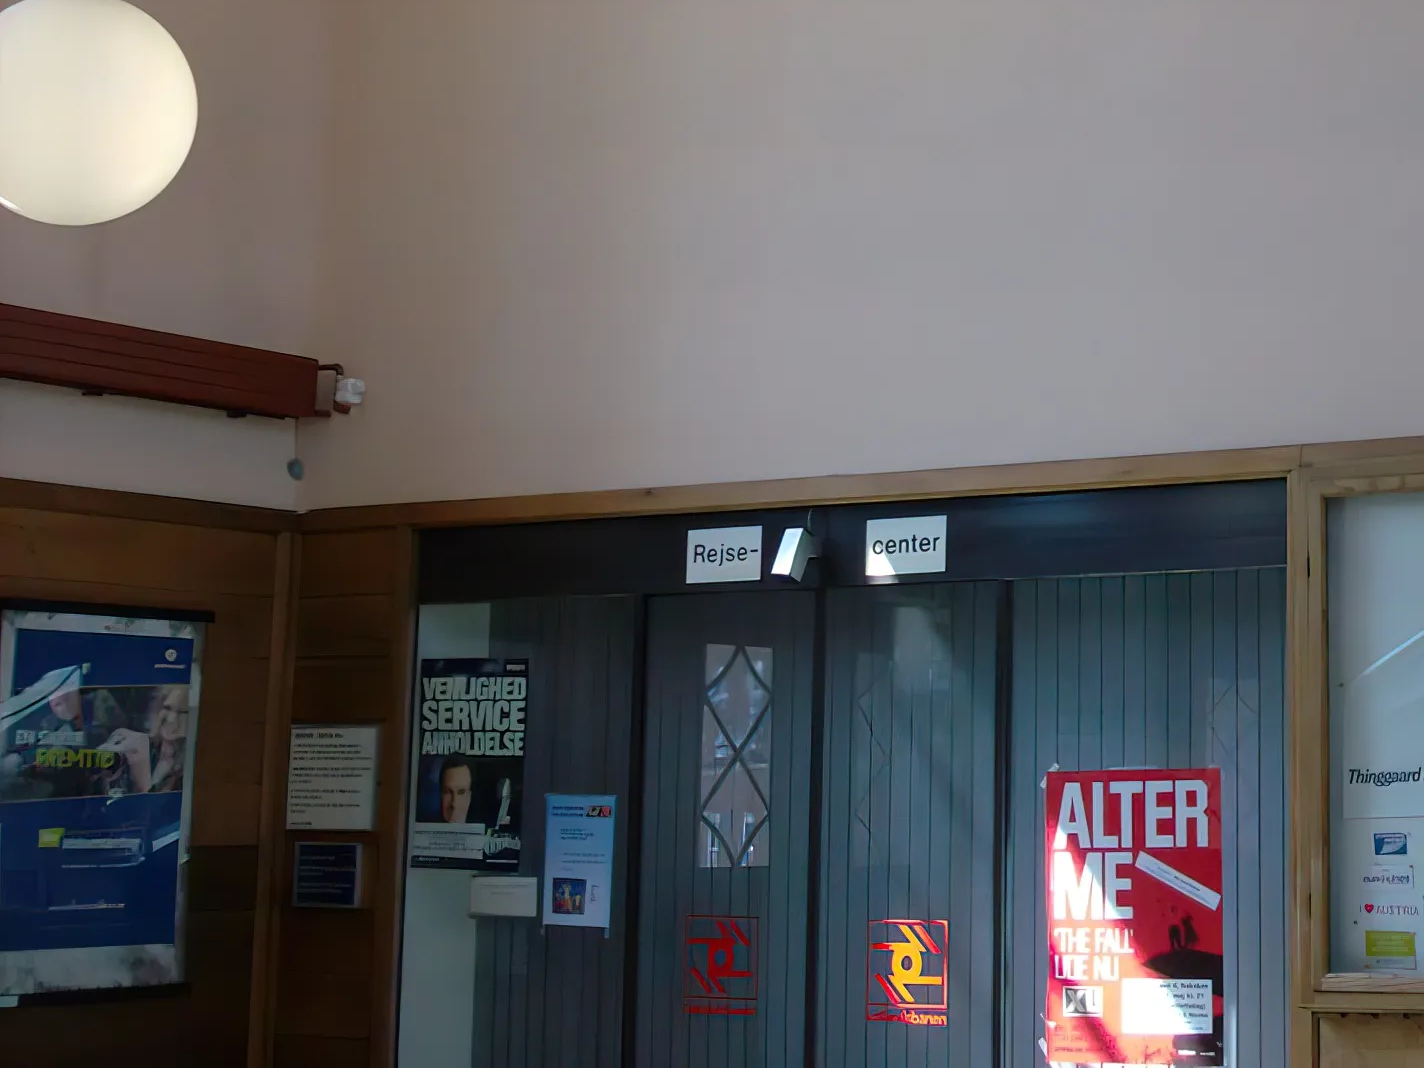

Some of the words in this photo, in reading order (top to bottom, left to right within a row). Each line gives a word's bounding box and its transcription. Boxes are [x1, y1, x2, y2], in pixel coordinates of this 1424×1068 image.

[692, 543, 759, 566] Rejse-
[872, 534, 940, 555] center
[422, 700, 527, 731] SERVICE
[1349, 766, 1421, 786] Thinggaard
[1053, 779, 1209, 849] ALTER
[1053, 851, 1134, 921] ME
[1093, 955, 1120, 981] NU
